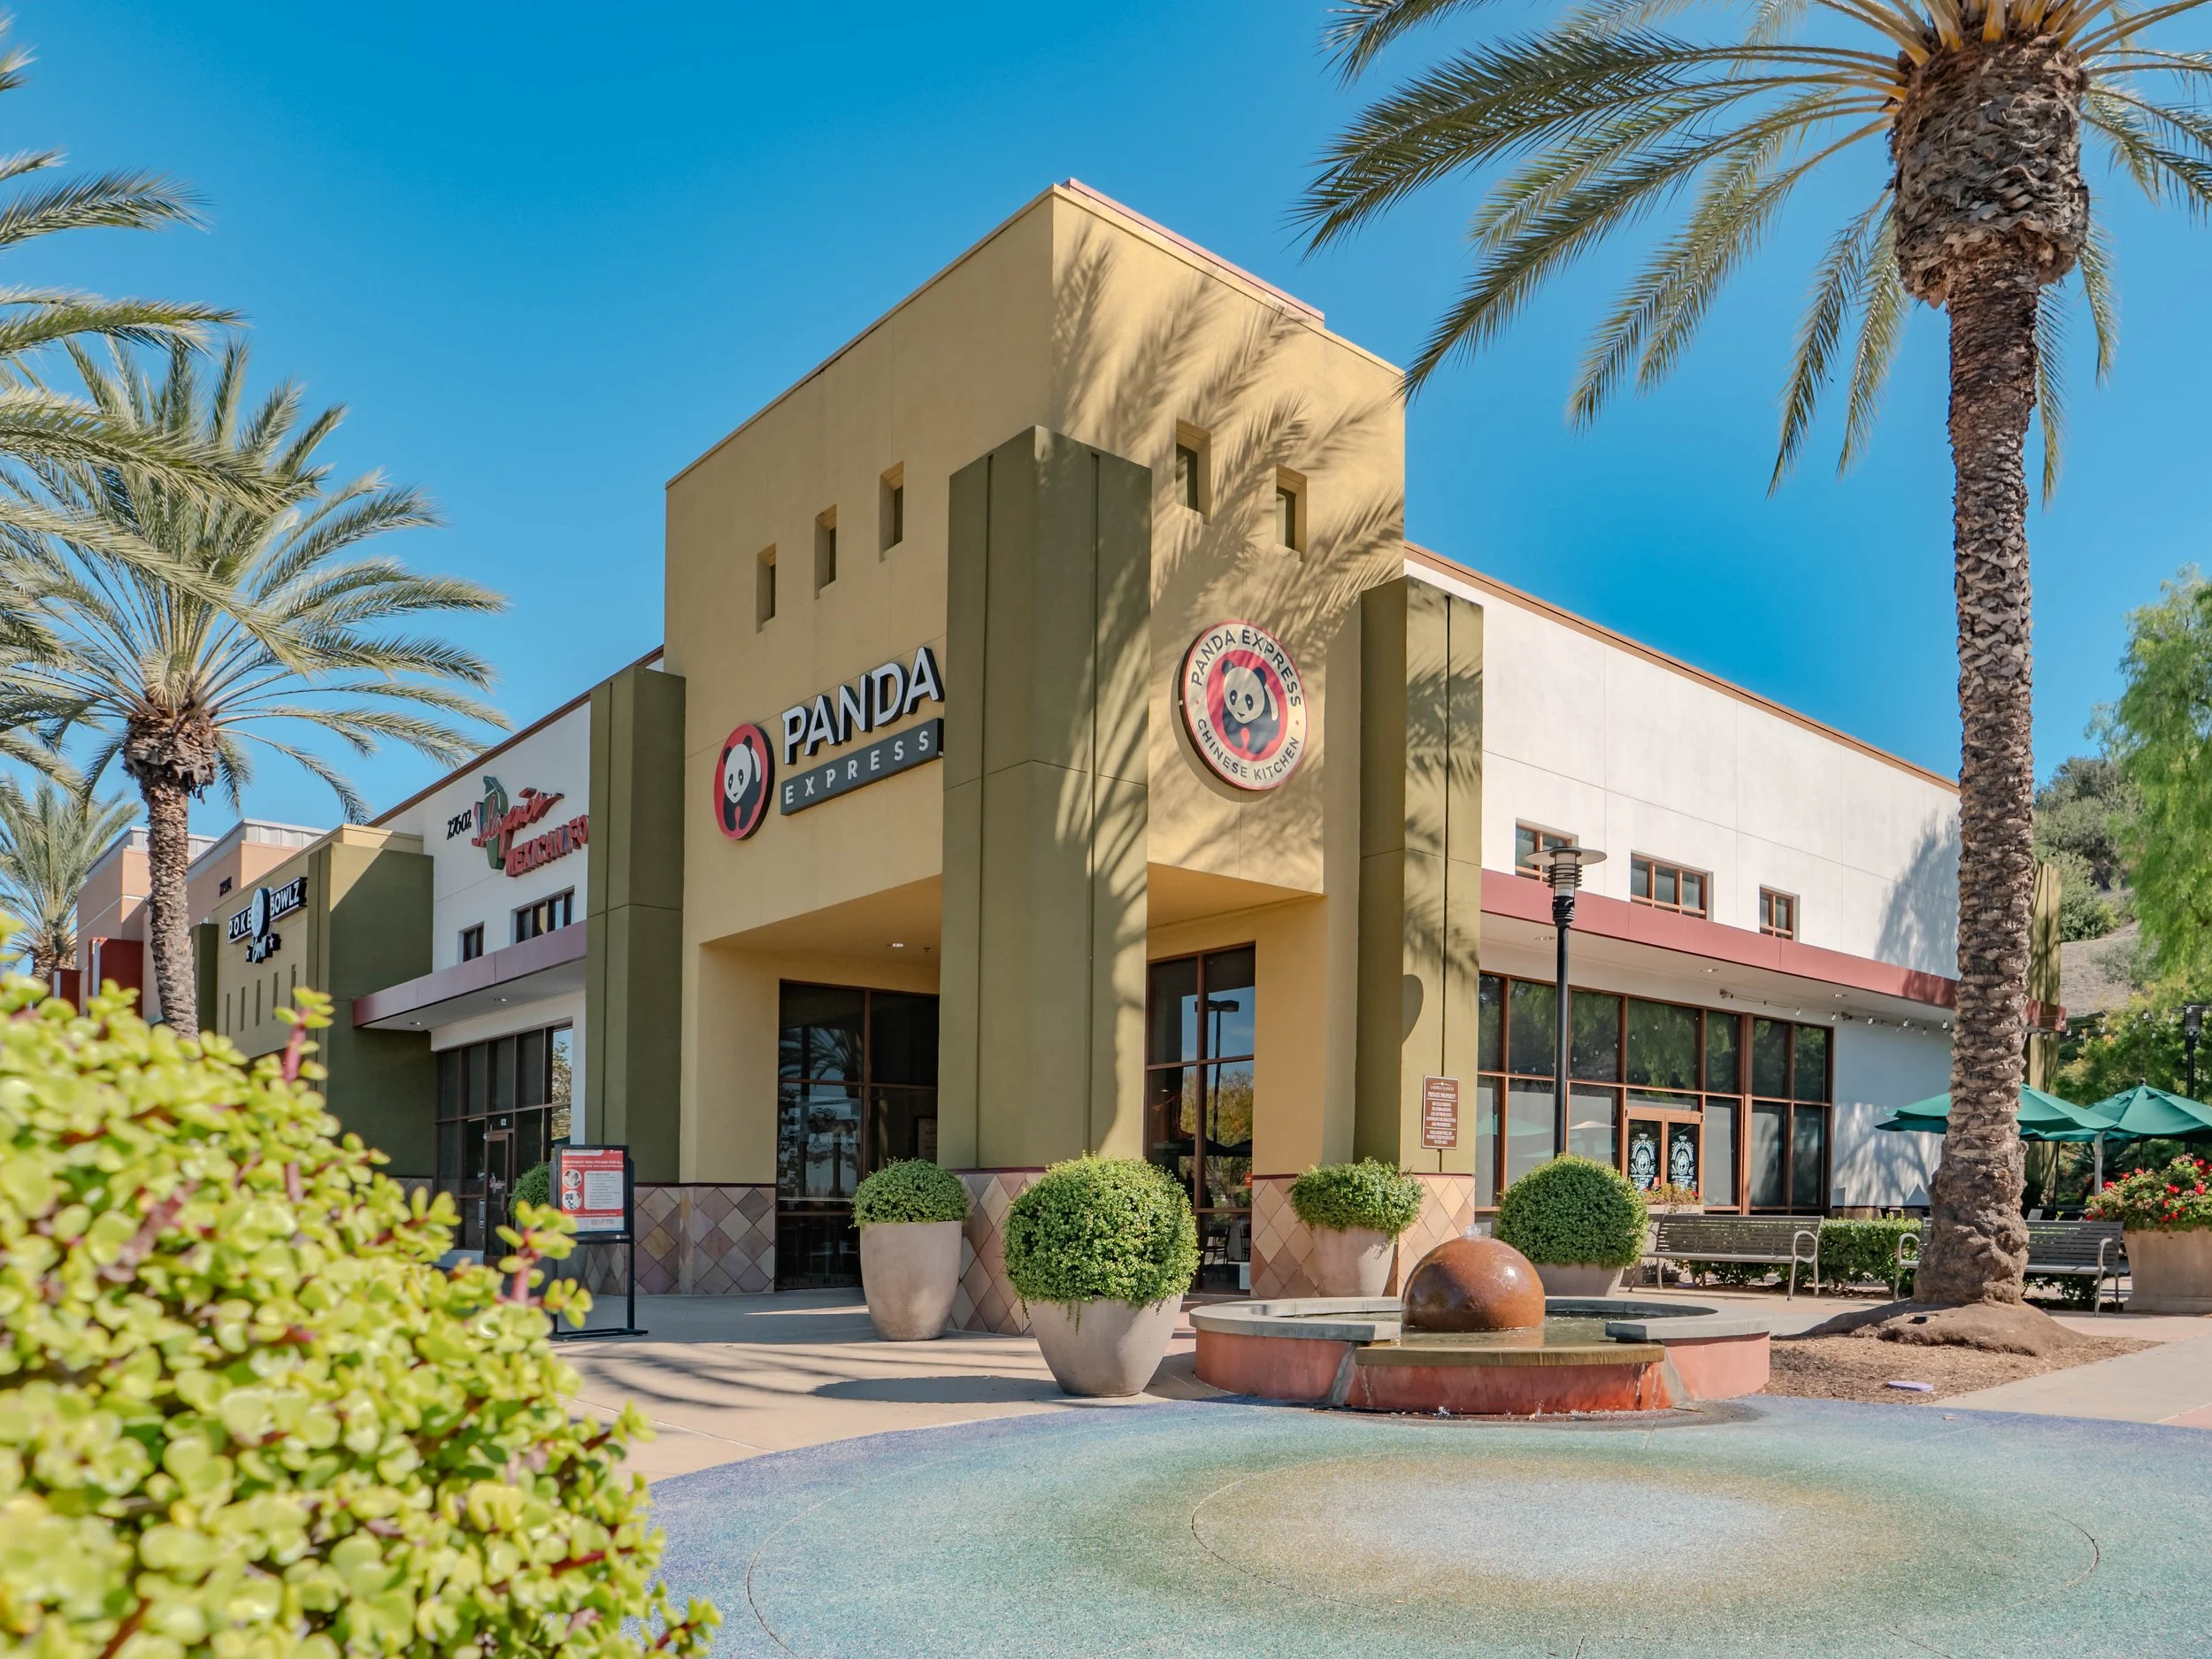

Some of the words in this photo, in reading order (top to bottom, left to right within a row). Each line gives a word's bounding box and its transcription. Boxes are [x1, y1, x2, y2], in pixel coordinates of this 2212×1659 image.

[1191, 629, 1236, 687] PANDA
[1241, 629, 1302, 708] EXPRESS
[781, 646, 945, 764] PANDA
[784, 730, 930, 805] EXPRESS
[1197, 718, 1248, 778] CHINESE
[1253, 736, 1299, 780] KITCHEN
[447, 810, 472, 840] 27602
[505, 824, 572, 878] MEXICAN
[568, 815, 589, 849] FO
[227, 909, 251, 939] POKE
[270, 881, 300, 916] BOWLZ
